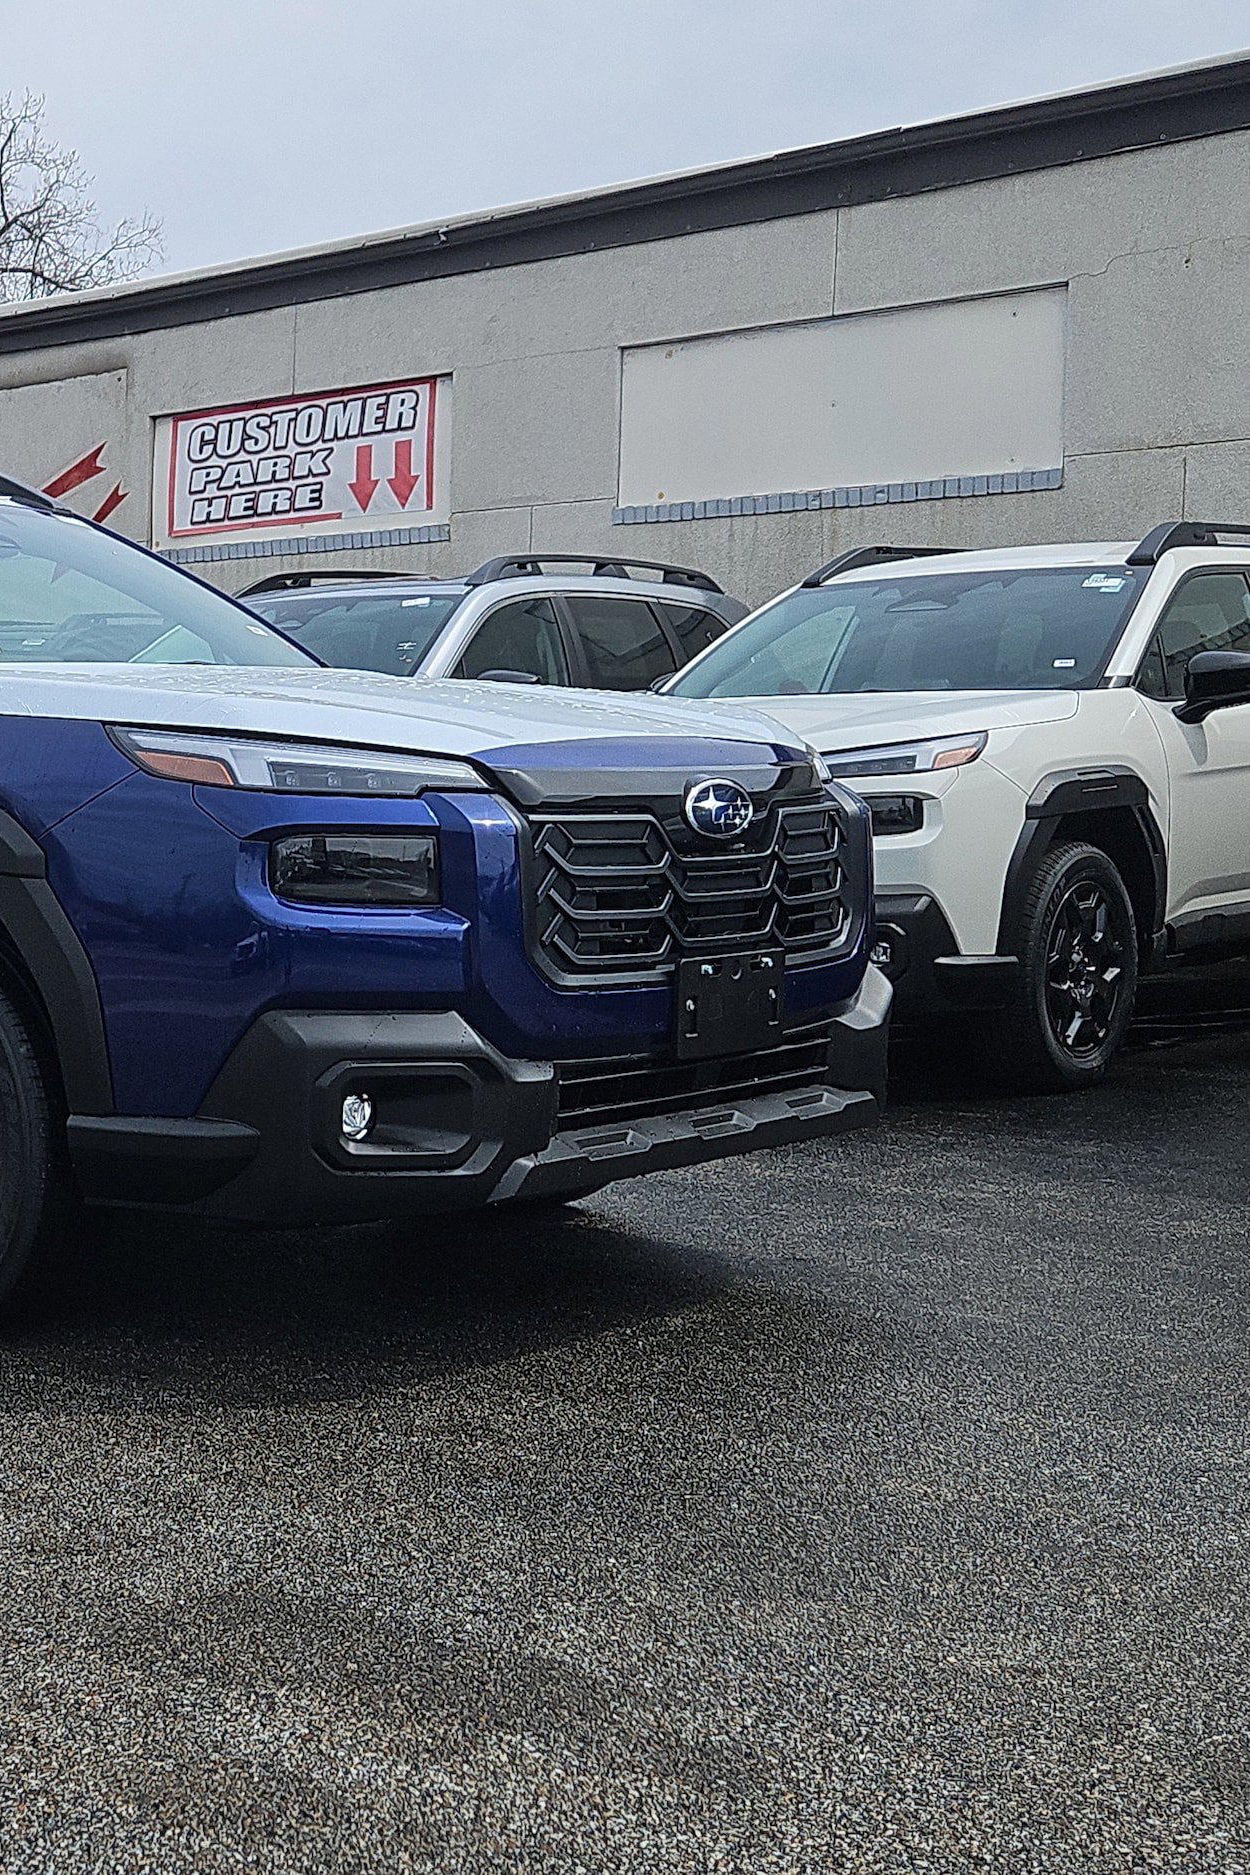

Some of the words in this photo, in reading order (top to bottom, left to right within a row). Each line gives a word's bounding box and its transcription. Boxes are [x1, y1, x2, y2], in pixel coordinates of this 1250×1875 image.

[188, 390, 419, 463] CUSTOMER
[189, 447, 334, 495] PARK
[190, 482, 324, 525] HERE
